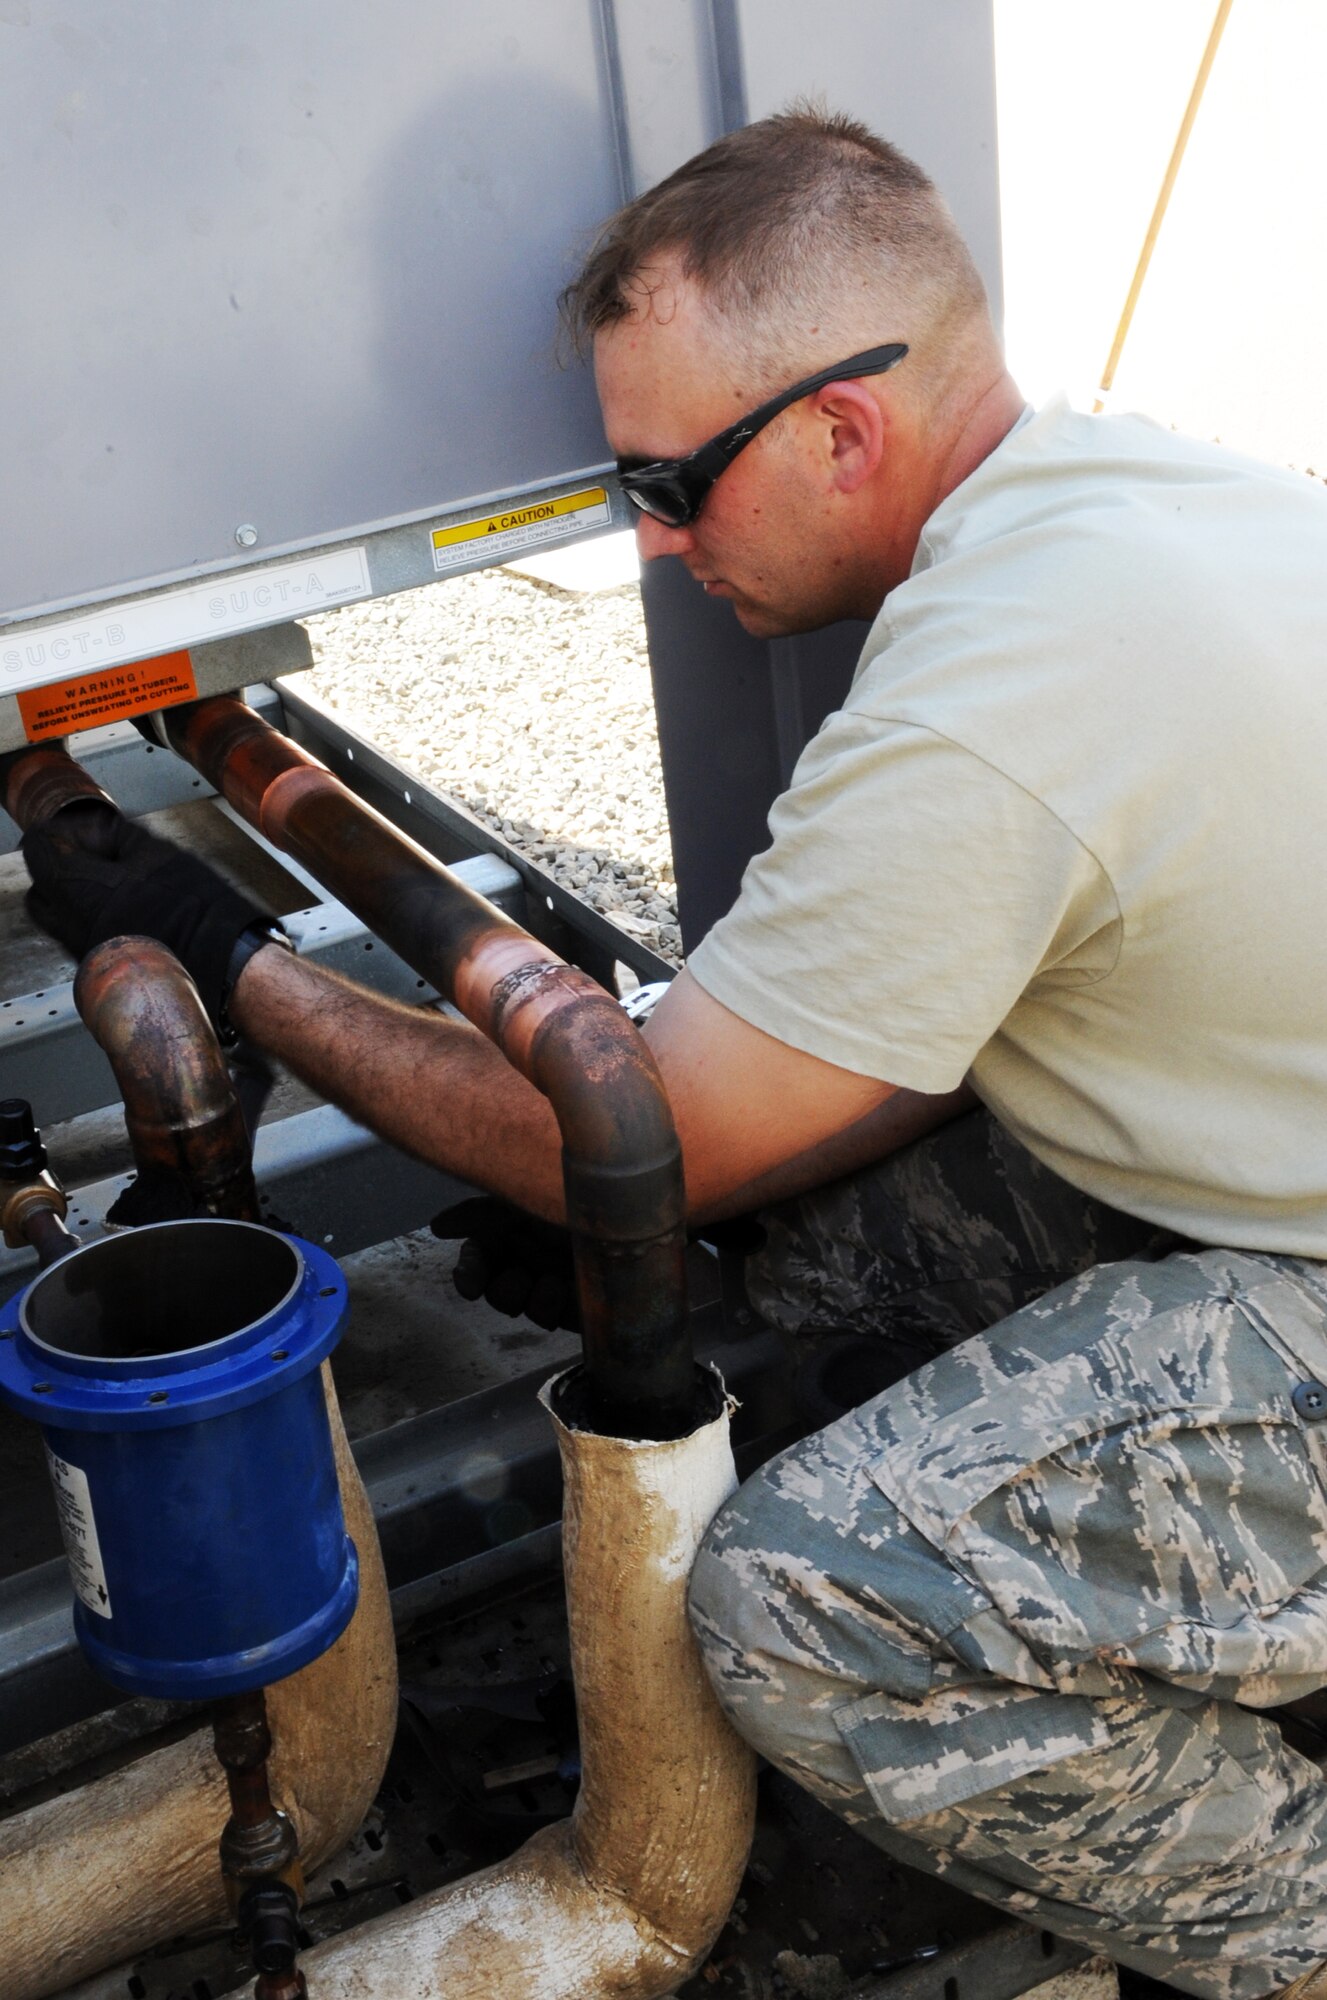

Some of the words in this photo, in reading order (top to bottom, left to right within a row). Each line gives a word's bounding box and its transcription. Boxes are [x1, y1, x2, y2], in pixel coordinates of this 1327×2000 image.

[438, 543, 464, 557] SYSTEM
[465, 535, 495, 550] FACTORY
[496, 528, 526, 542] CHARGED
[527, 523, 543, 533] WITH
[544, 512, 576, 527] NITROGEN
[501, 505, 554, 528] CAUTION
[439, 552, 466, 565] RELIEVE
[466, 543, 501, 558] PRESSURE
[501, 535, 526, 549] BEFORE
[528, 525, 569, 541] CONNECTING
[569, 520, 583, 531] PIPE
[208, 572, 324, 619] SUCT-A
[3, 624, 126, 672] SUCT-B
[32, 716, 68, 731] BEFORE
[71, 699, 132, 720] UNSWEATING
[134, 694, 147, 703] OR
[150, 682, 189, 699] CUTTING
[37, 703, 76, 718] RELIEVE
[79, 689, 126, 707] PRESSURE
[129, 686, 139, 694] IN
[142, 676, 177, 690] TUBE(S)
[65, 673, 136, 698] WARNING
